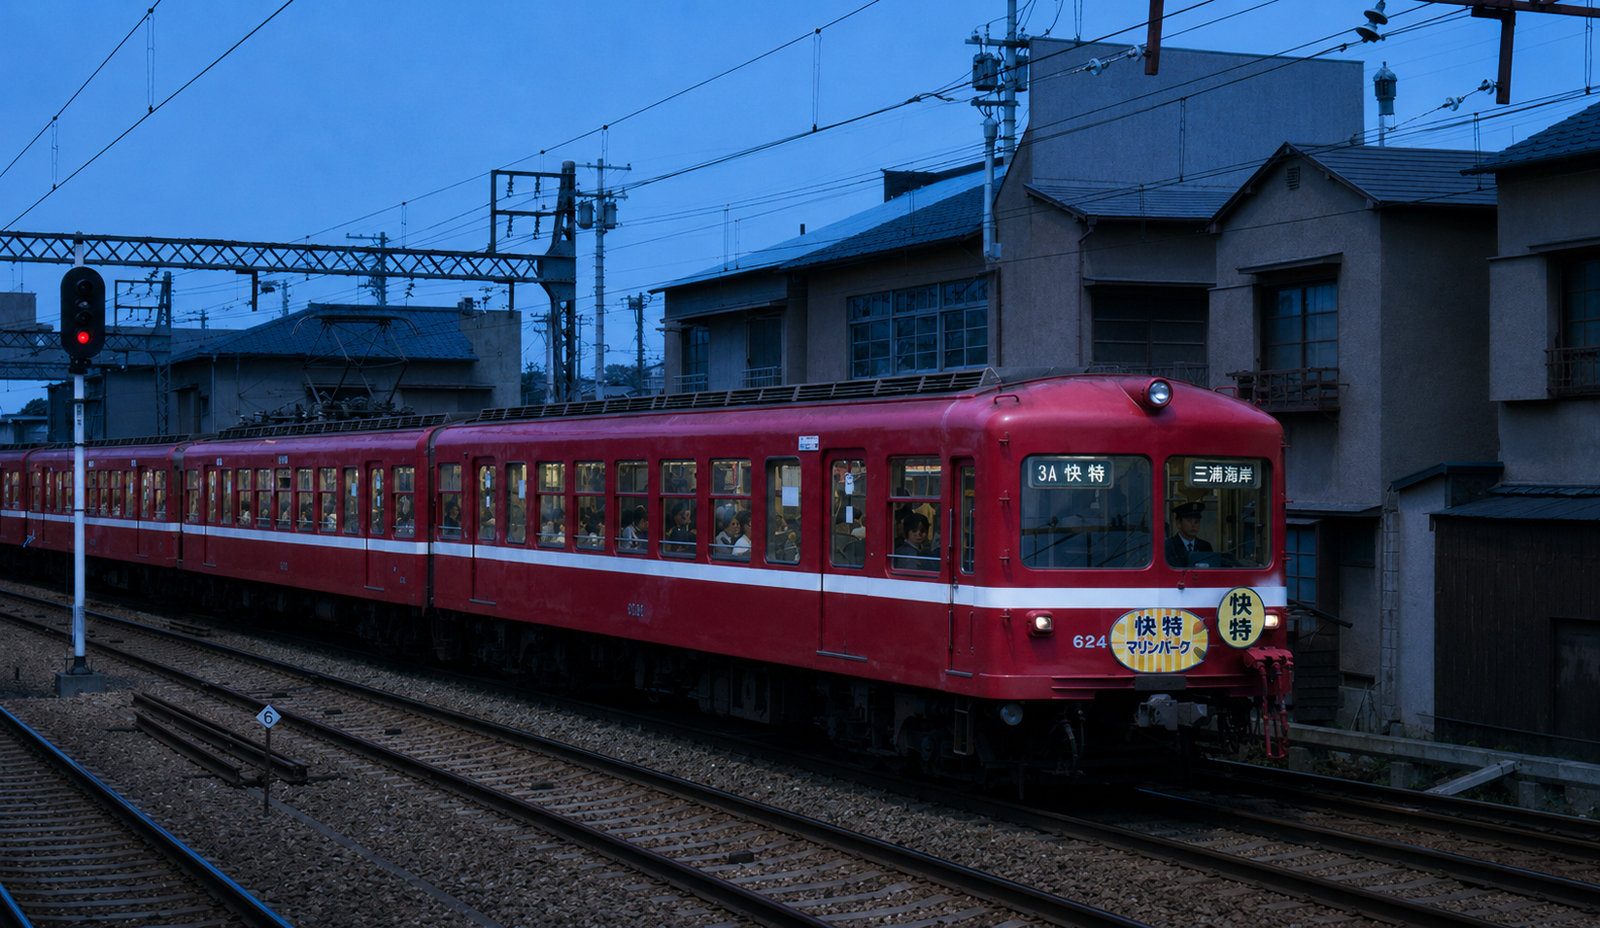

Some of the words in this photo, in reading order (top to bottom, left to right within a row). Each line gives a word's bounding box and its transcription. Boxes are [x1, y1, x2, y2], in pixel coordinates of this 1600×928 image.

[1038, 464, 1057, 482] 3A
[1064, 463, 1105, 482] 快特
[1193, 465, 1253, 483] 三浦海岸
[1135, 615, 1183, 637] 快特
[1229, 592, 1253, 642] 快特
[1073, 635, 1107, 648] 624
[1126, 640, 1191, 655] マリンパーク
[264, 711, 273, 724] 6
